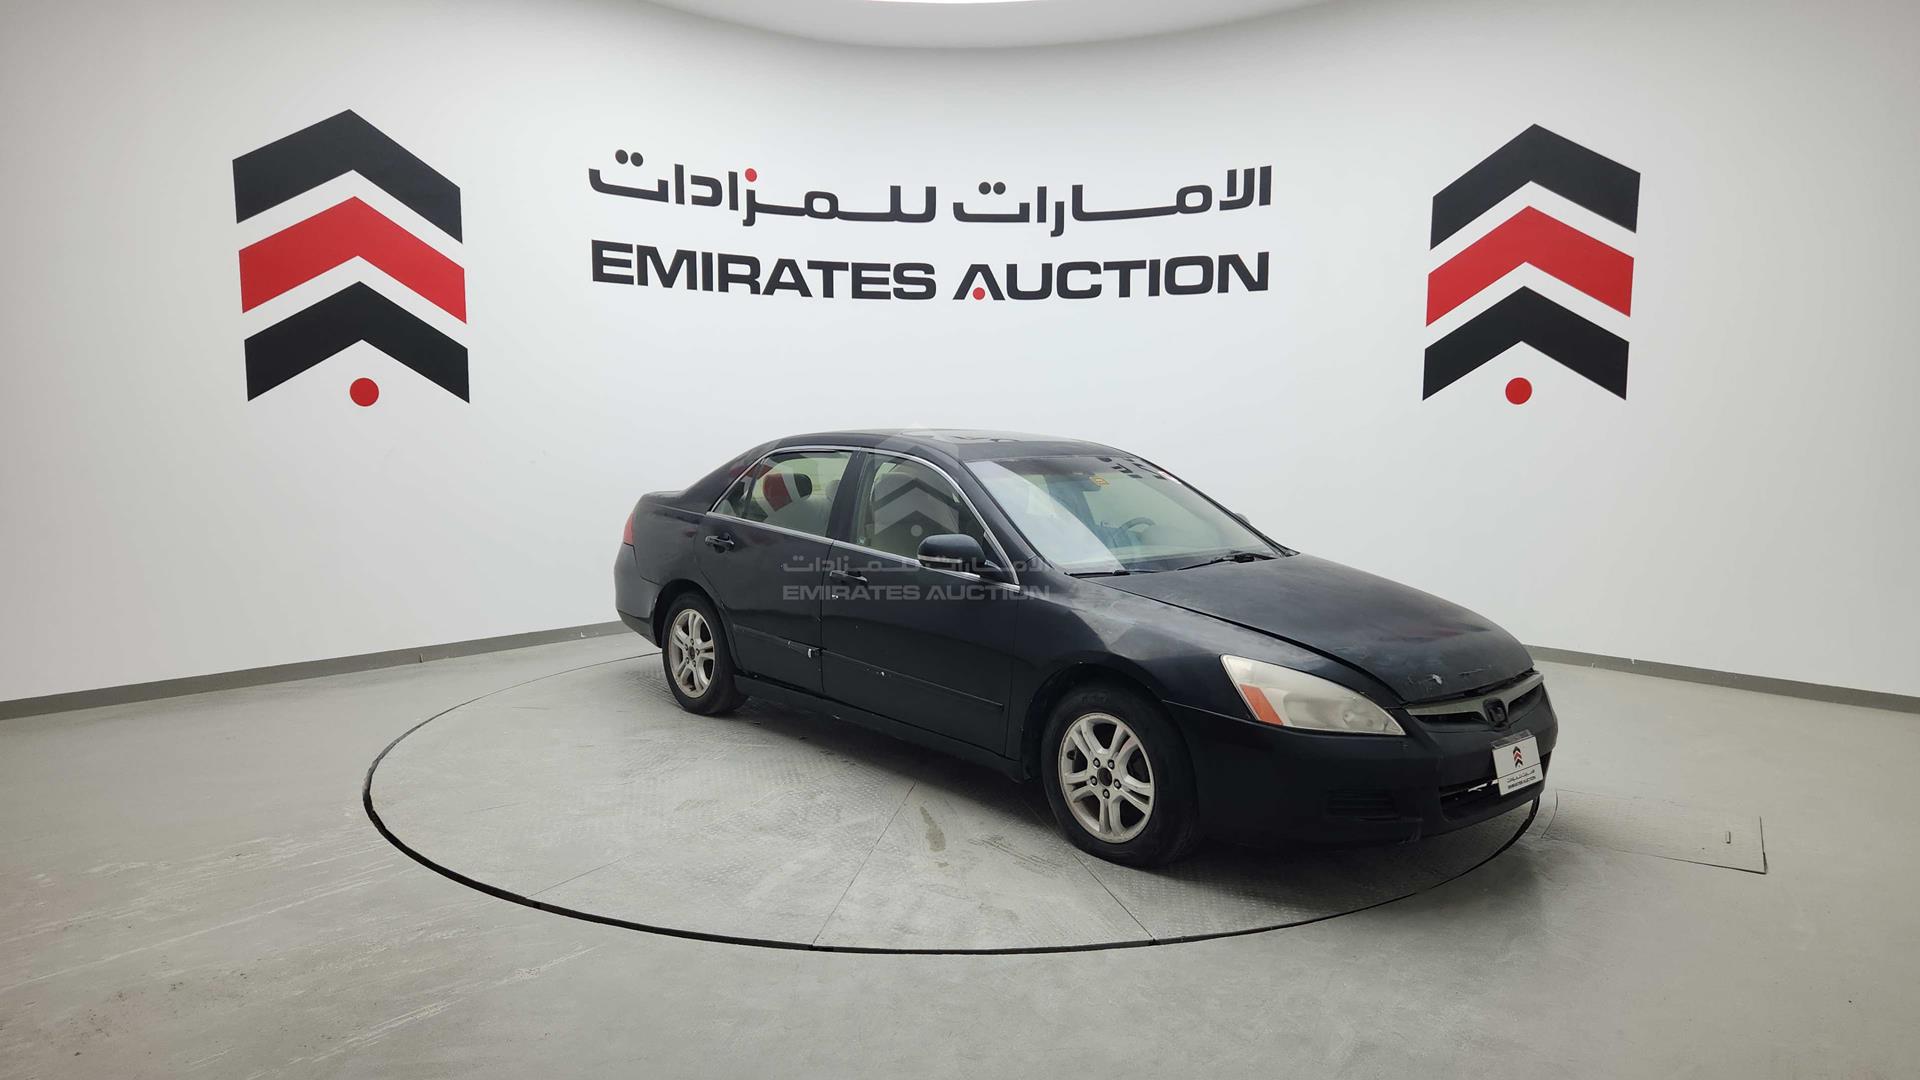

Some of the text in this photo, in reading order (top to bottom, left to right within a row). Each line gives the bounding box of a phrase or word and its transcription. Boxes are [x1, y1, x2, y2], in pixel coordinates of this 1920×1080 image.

[588, 149, 937, 227] للمزادات
[591, 239, 1270, 301] EMIRATES AUCTION
